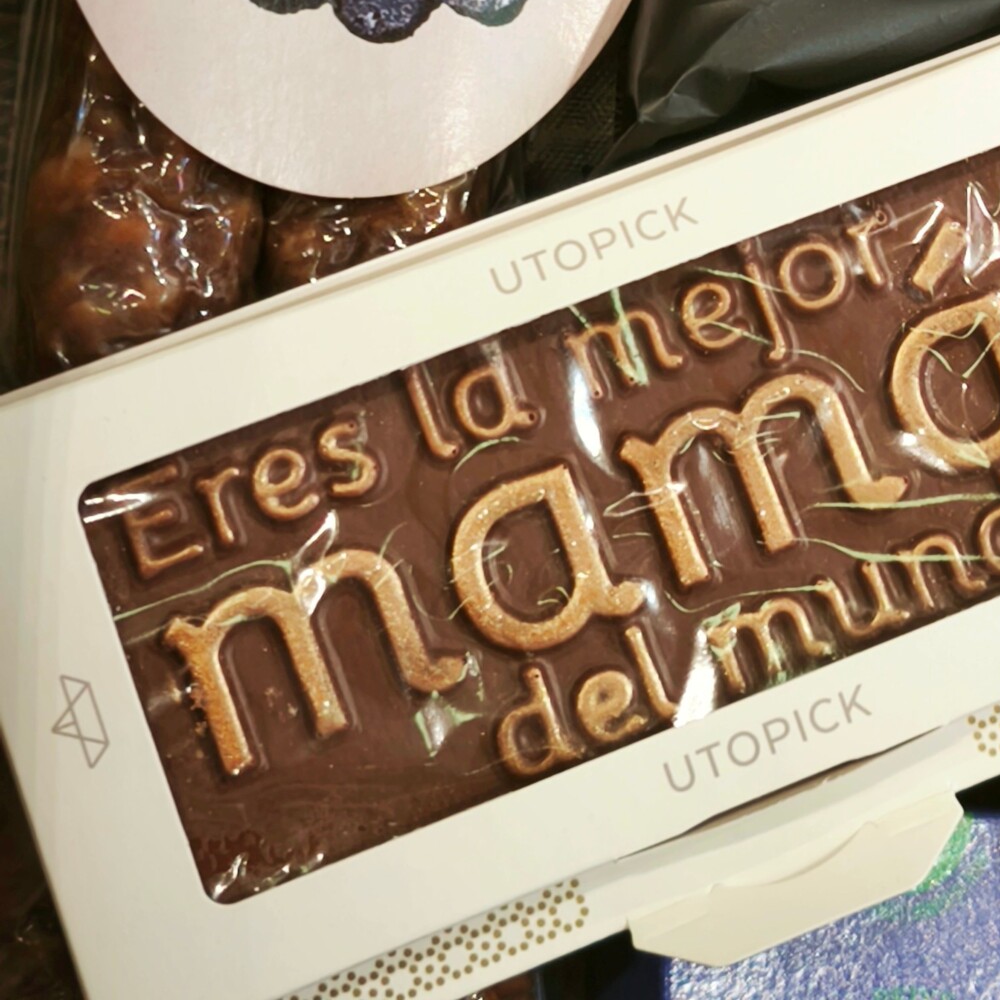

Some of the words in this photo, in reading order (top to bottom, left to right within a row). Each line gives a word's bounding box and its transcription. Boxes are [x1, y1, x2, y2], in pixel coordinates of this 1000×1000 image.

[489, 196, 699, 296] UTOPICK
[119, 419, 380, 575] Eres
[409, 362, 538, 460] la
[566, 208, 891, 400] mejor
[498, 625, 680, 778] del
[662, 684, 872, 793] UTOPICK
